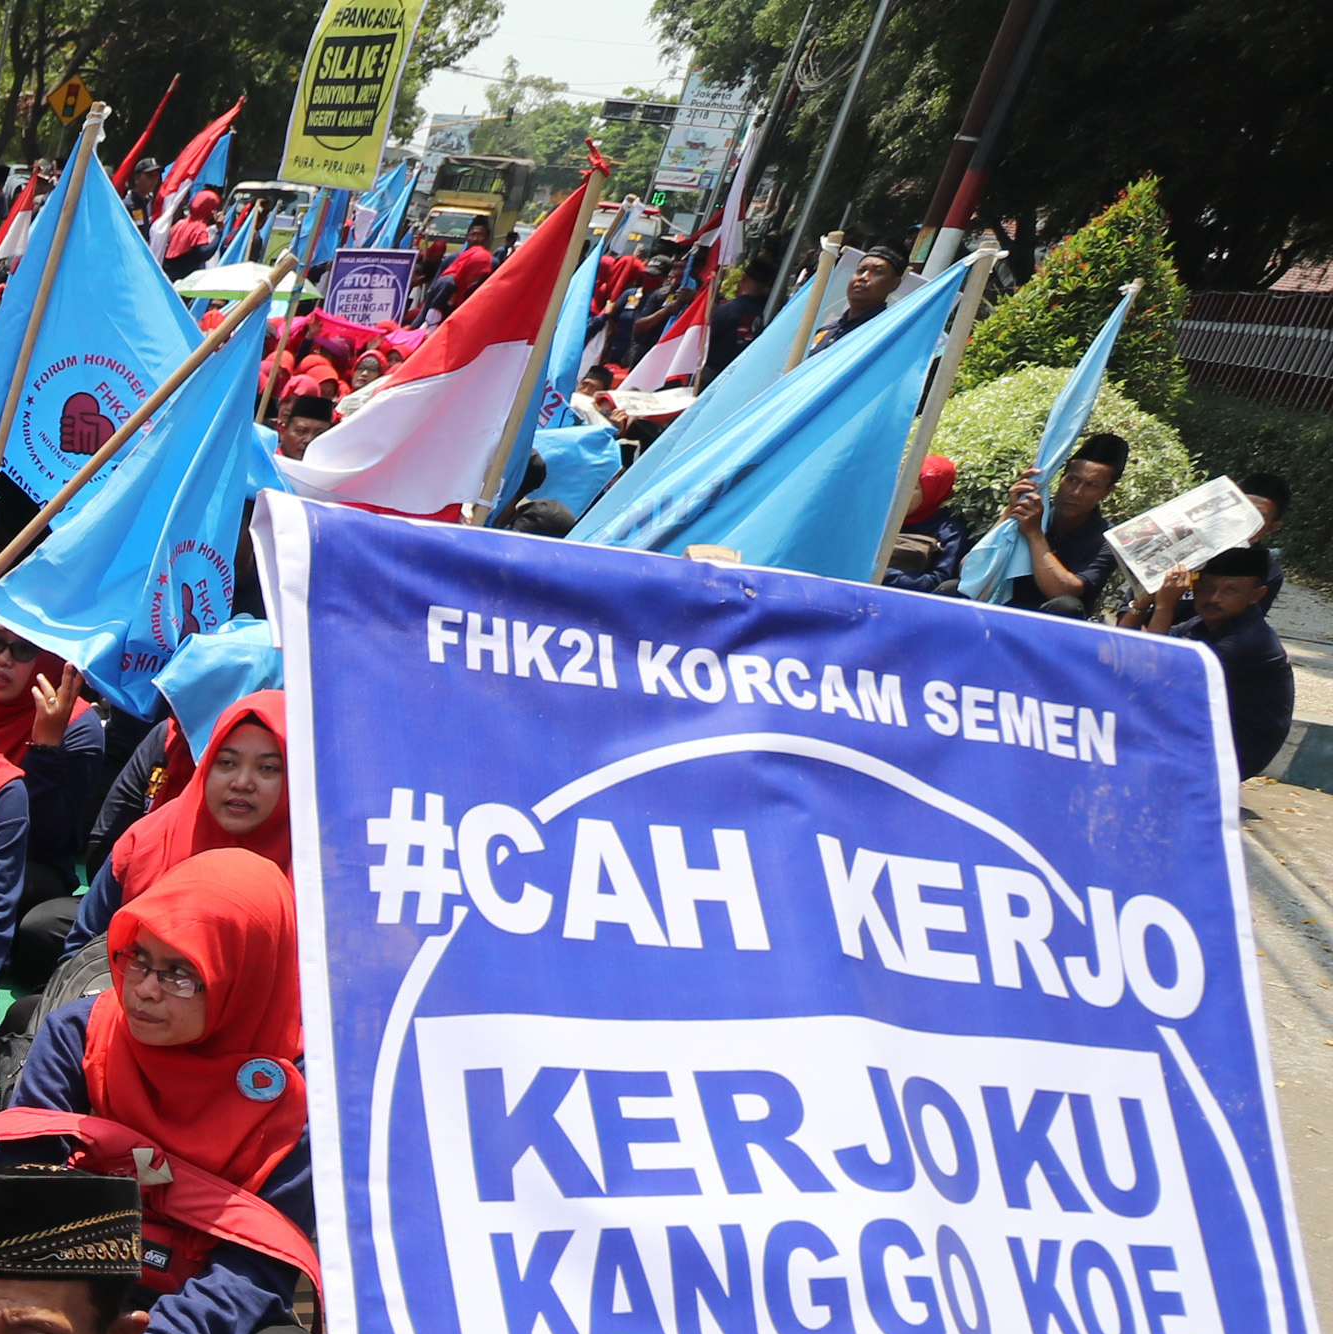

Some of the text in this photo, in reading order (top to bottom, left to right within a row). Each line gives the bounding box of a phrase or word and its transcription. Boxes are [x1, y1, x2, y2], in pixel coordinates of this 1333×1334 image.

[334, 7, 406, 29] #PANCASILA
[318, 43, 393, 80] SILA KE 5
[693, 88, 733, 100] Jakarta
[293, 156, 315, 167] PURA
[322, 159, 343, 171] PURA
[344, 161, 366, 175] LUPA
[651, 191, 667, 206] 10
[343, 273, 398, 288] #TOBAT
[337, 302, 392, 313] KERINGAT
[338, 293, 374, 303] PERAS
[33, 353, 148, 401] FORUM HONORER
[426, 605, 1118, 767] FHK2I KORCAM SEMEN
[366, 787, 1206, 1020] #CAH KERJO
[463, 1065, 1161, 1219] KERJOKU
